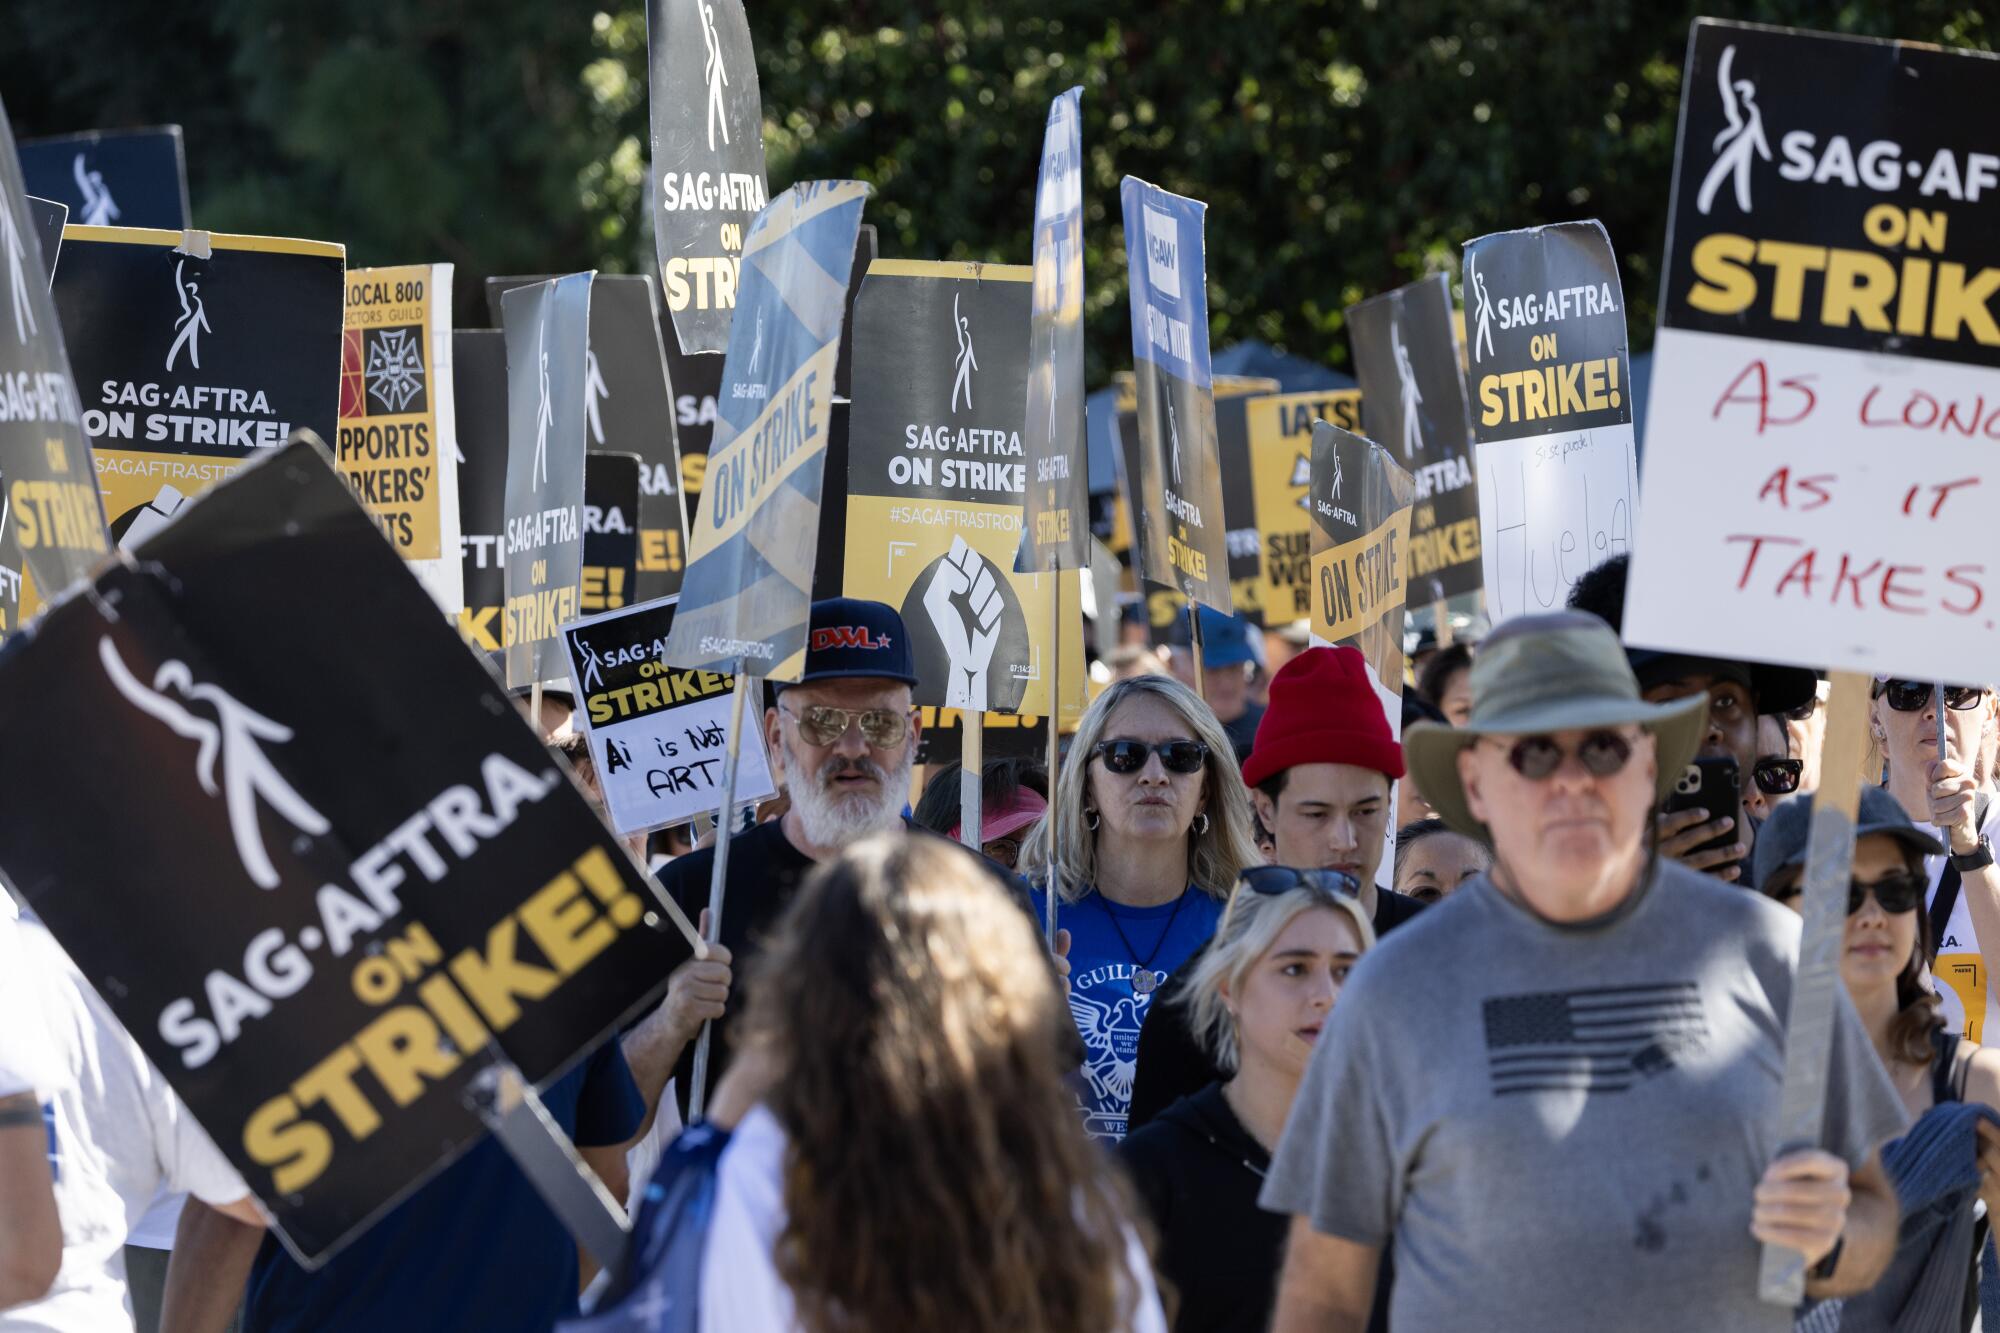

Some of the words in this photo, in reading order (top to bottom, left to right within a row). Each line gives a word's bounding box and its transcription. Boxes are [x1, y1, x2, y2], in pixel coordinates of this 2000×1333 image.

[720, 223, 742, 250] ON
[1863, 203, 1949, 253] ON
[346, 284, 391, 307] LOCAL
[395, 281, 424, 303] 800
[1686, 232, 2000, 347] STRIK
[388, 307, 424, 322] GUILD
[1531, 333, 1558, 362] ON
[1479, 357, 1621, 427] STRIKE!
[1711, 359, 1820, 435] AS
[83, 409, 135, 439] ON
[146, 415, 291, 448] STRIKE!
[713, 447, 746, 529] ON
[751, 370, 818, 498] STRIKE
[888, 455, 933, 486] ON
[940, 459, 1025, 493] STRIKE
[1759, 466, 1838, 512] AS
[1901, 476, 1981, 521] IT
[1037, 509, 1069, 545] STRIKE!
[531, 560, 547, 586] ON
[1168, 535, 1208, 582] STRIKE!
[1320, 559, 1353, 627] ON
[1356, 527, 1399, 613] STRIKE
[507, 586, 577, 647] STRIKE!
[639, 661, 669, 679] ON
[587, 669, 734, 724] STRIKE!
[655, 738, 678, 758] is
[684, 719, 725, 751] Not
[646, 758, 720, 799] ART
[352, 921, 443, 1004] ON
[242, 845, 644, 1195] STRIKE!
[1113, 1033, 1140, 1042] united
[1103, 1121, 1128, 1132] WE
